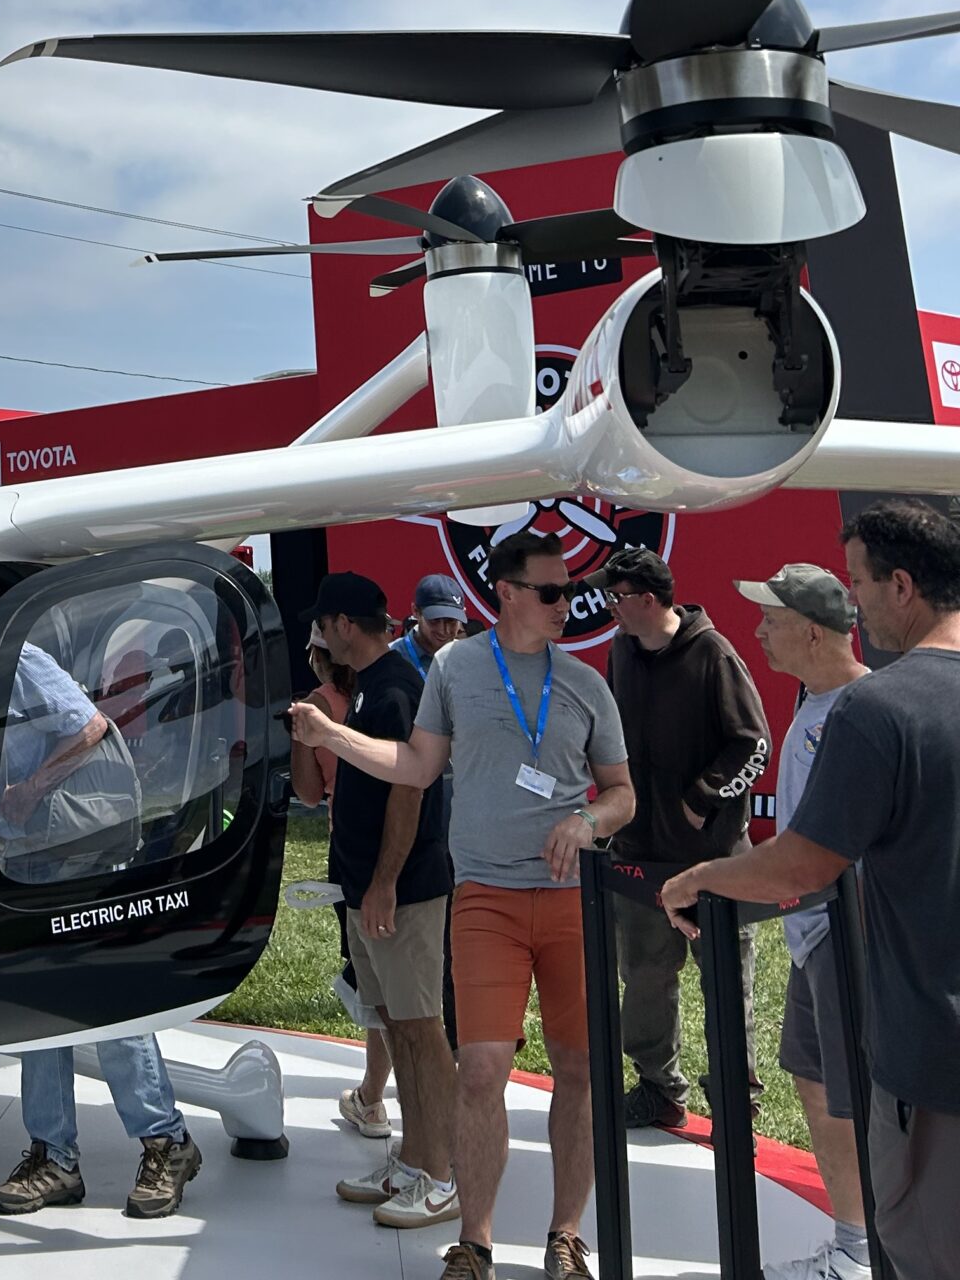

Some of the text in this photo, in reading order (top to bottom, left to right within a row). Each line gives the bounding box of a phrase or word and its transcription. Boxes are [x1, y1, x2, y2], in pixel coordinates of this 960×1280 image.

[522, 263, 558, 283] ME
[6, 444, 77, 473] TOYOTA
[565, 588, 606, 621] CH
[719, 738, 767, 798] adidas
[50, 890, 189, 934] ELECTRIC AIR TAXI
